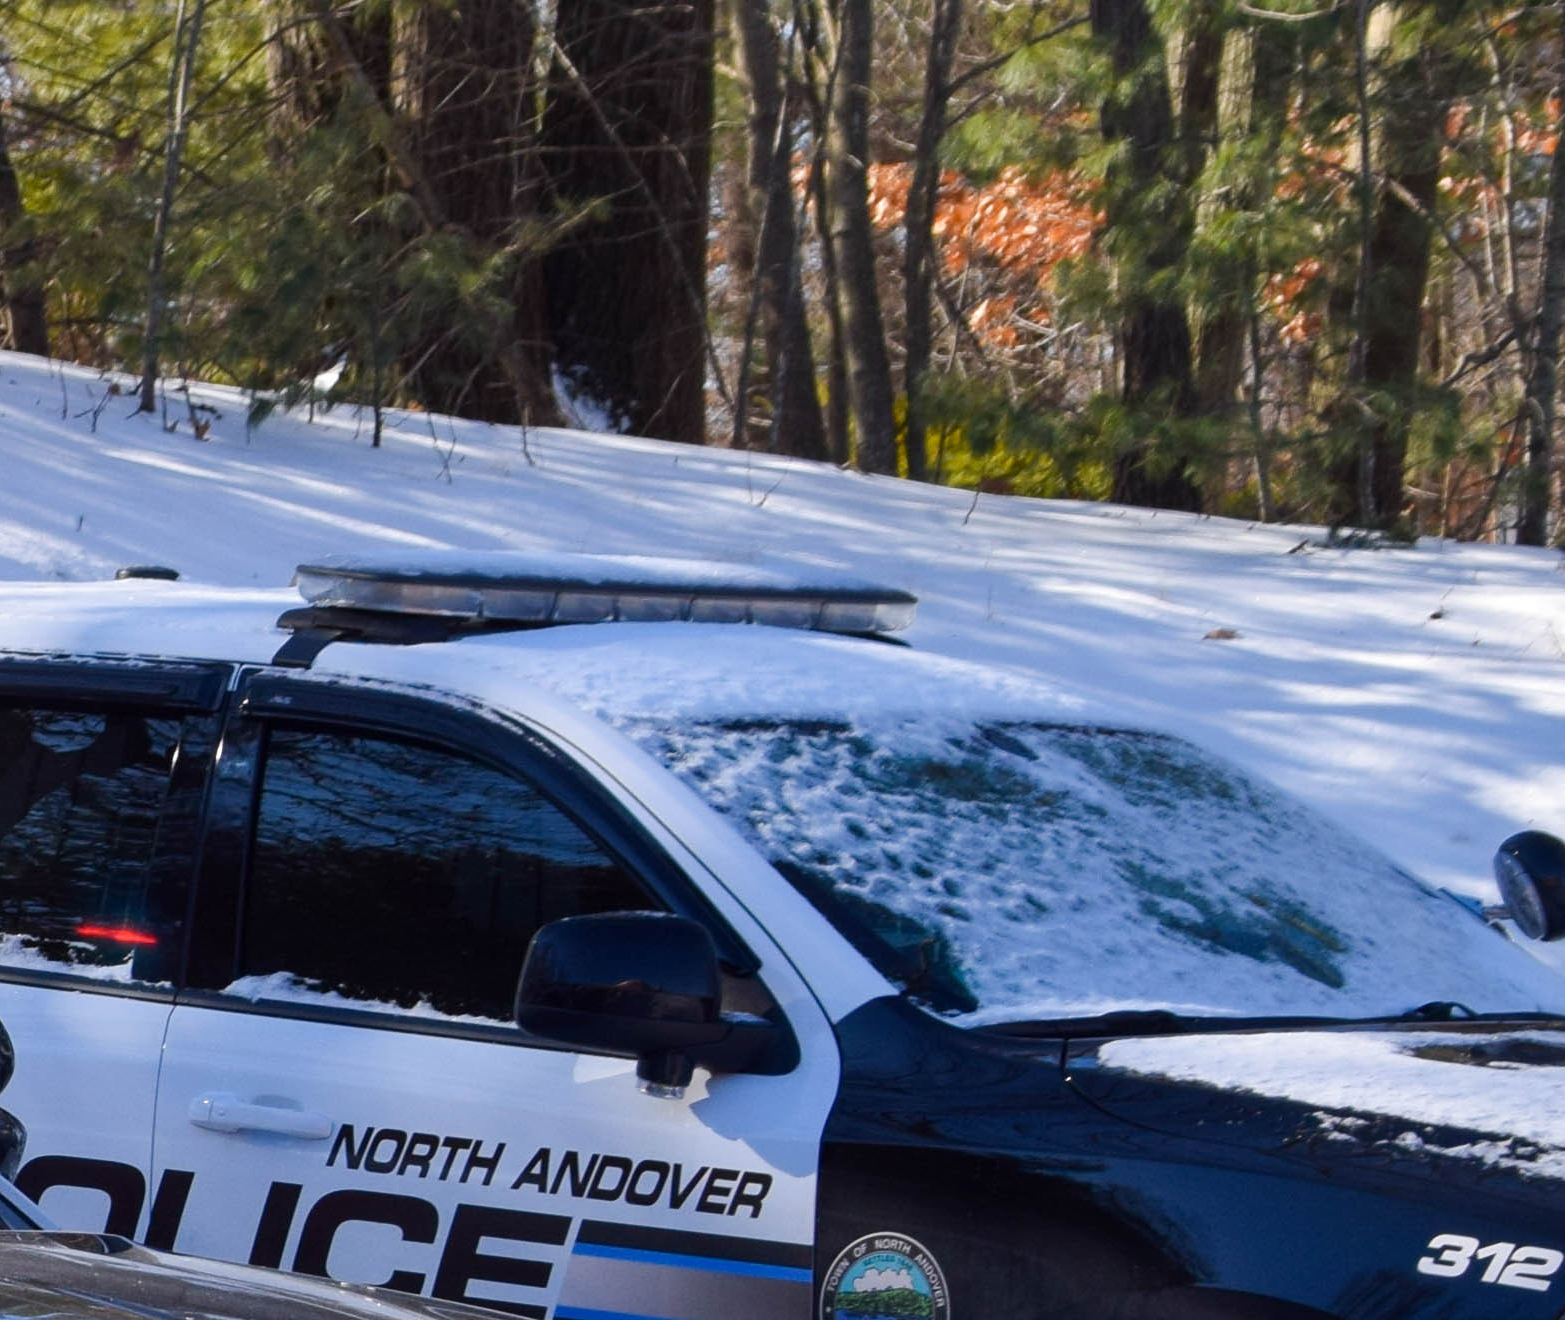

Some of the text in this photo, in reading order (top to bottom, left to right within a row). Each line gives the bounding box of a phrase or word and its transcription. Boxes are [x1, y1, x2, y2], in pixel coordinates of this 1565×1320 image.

[326, 1122, 773, 1219] NORTH ANDOVER
[827, 1258, 850, 1292] TOWN
[853, 1243, 869, 1258] OF
[875, 1238, 912, 1254] NORTH
[914, 1254, 945, 1308] ANDOVER
[1417, 1233, 1565, 1292] 312
